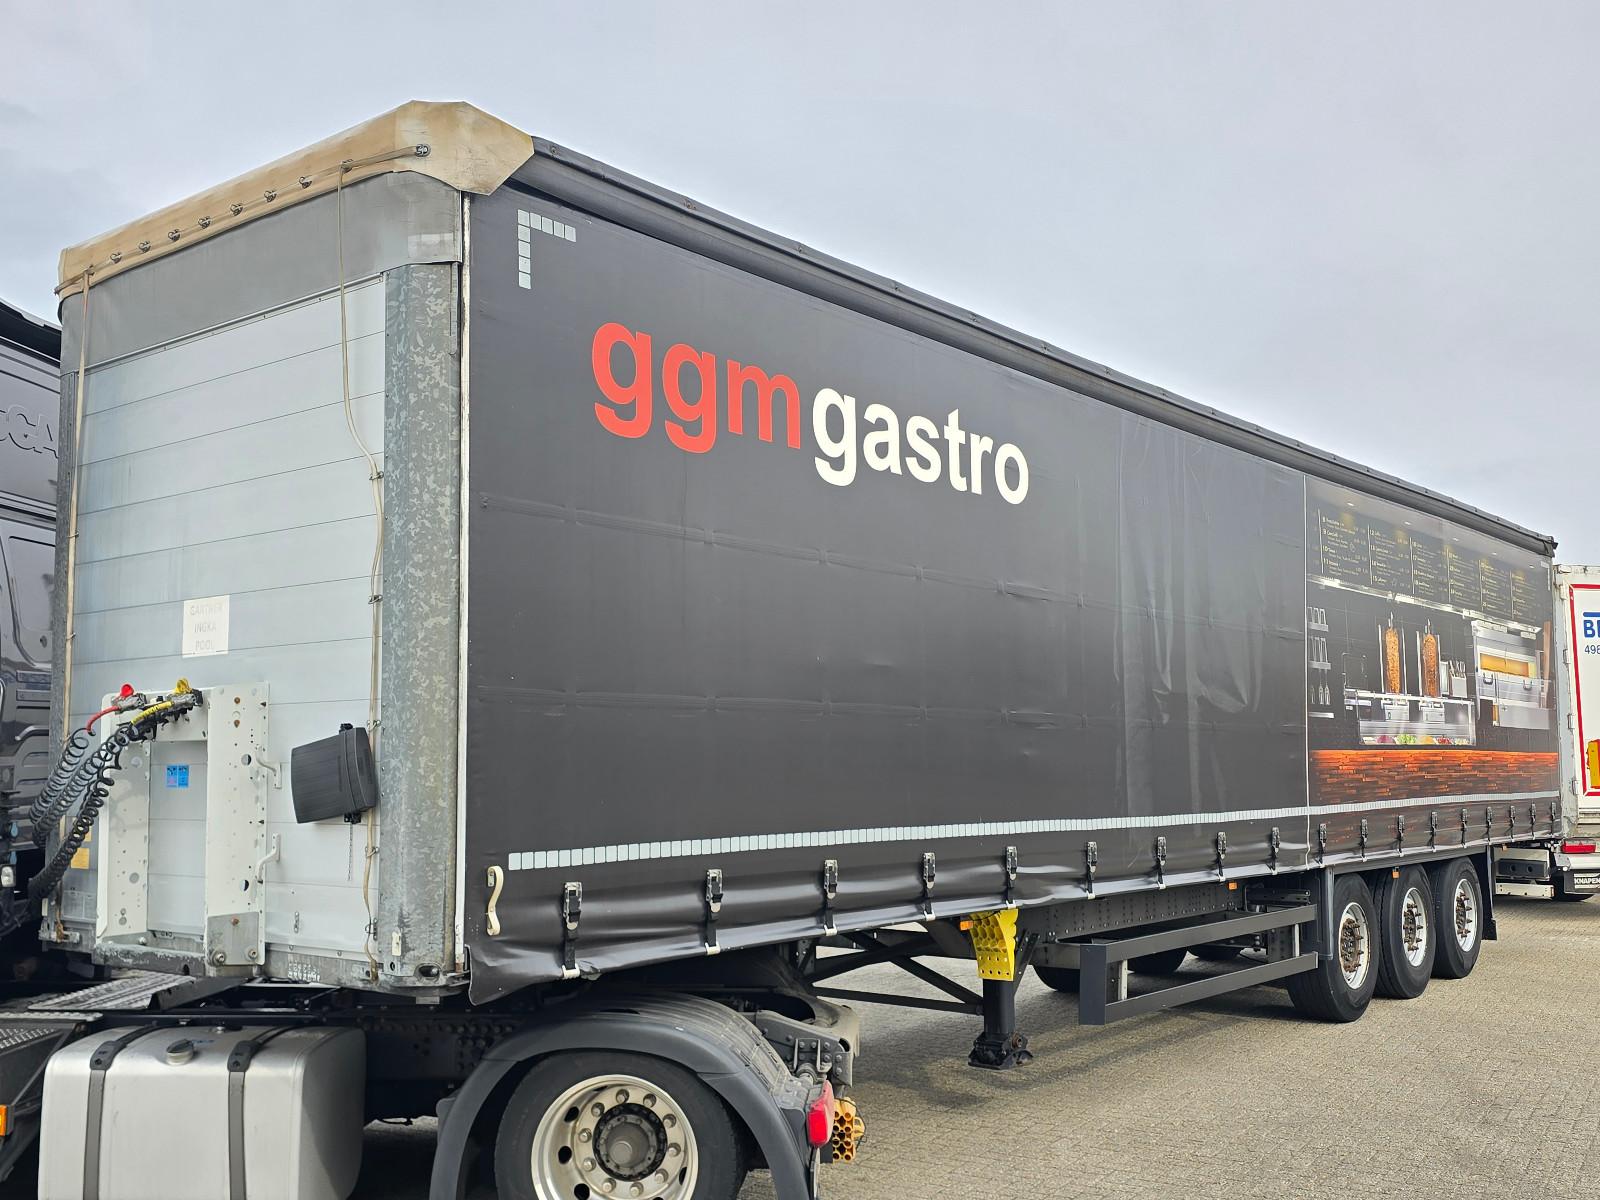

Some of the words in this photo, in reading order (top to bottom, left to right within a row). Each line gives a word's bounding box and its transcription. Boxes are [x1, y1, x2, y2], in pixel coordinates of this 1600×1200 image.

[592, 322, 801, 454] ggm
[812, 387, 1029, 505] gastro
[1583, 619, 1600, 638] B
